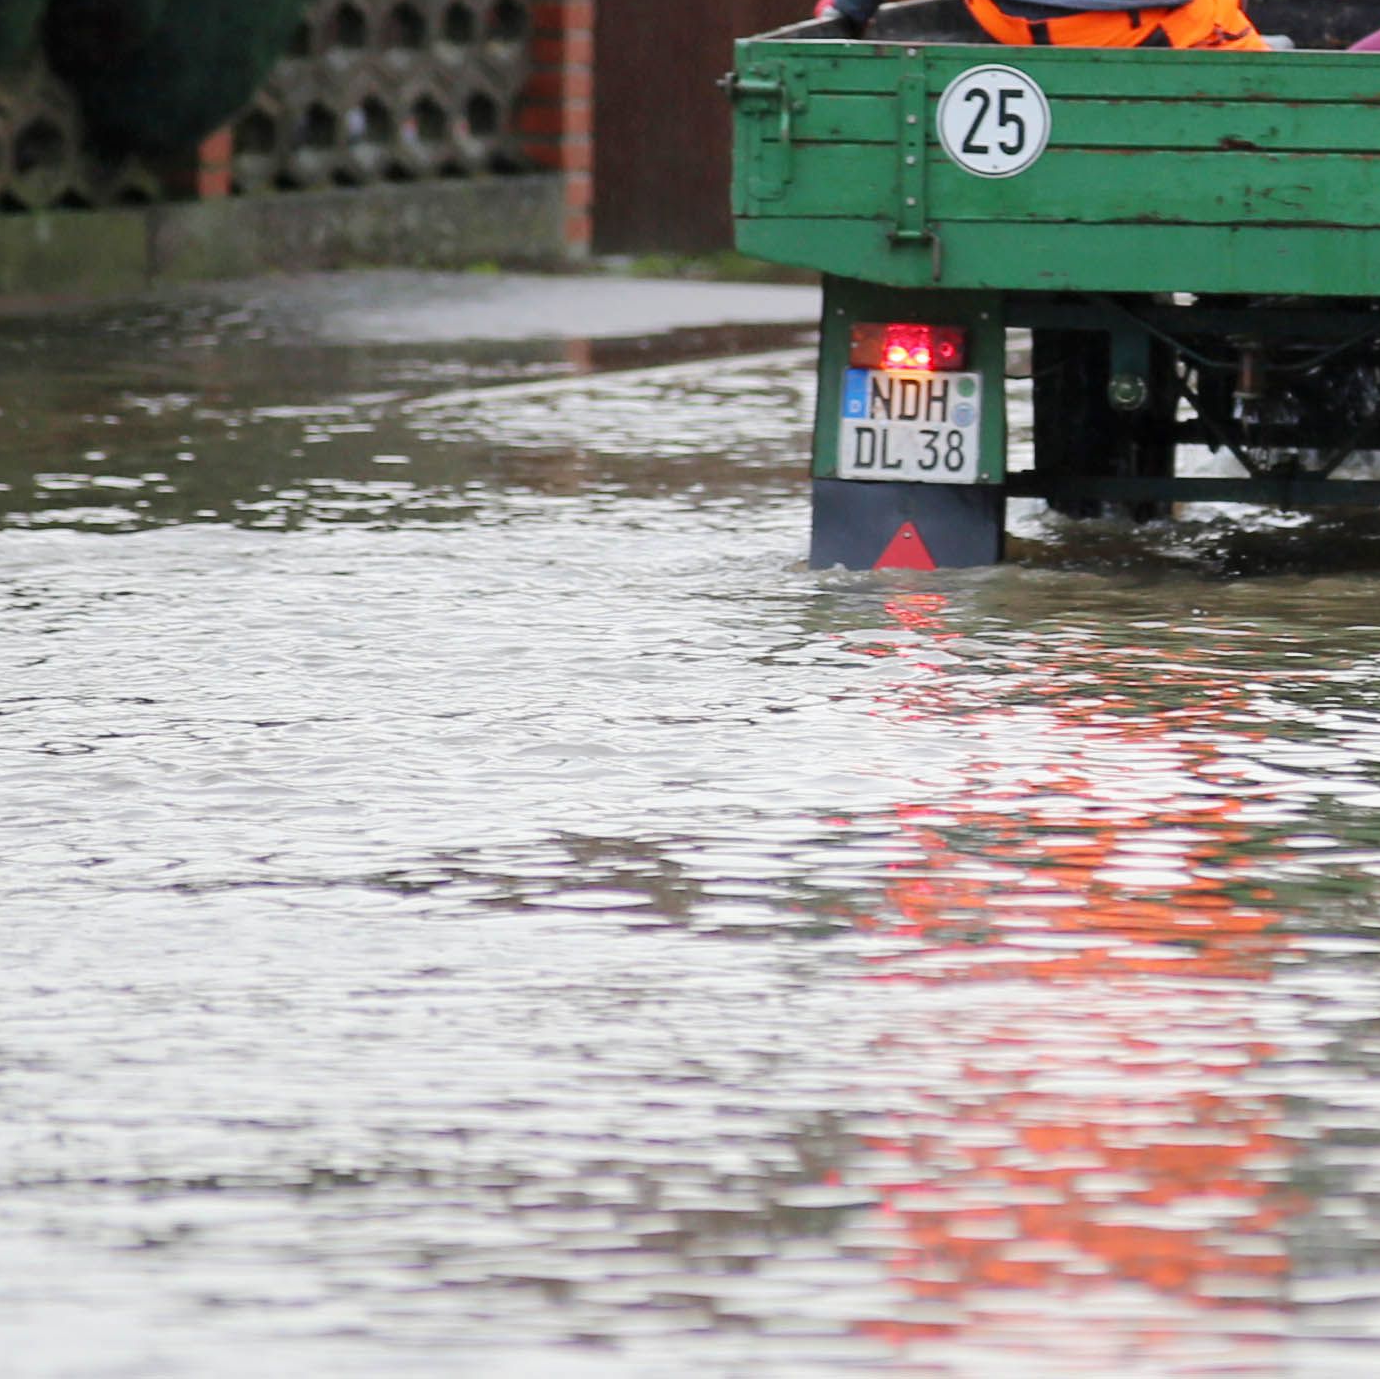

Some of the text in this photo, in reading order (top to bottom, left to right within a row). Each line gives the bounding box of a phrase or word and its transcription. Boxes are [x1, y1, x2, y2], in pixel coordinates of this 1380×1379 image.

[961, 87, 1025, 156] 25
[870, 377, 949, 422] NDH
[853, 427, 964, 472] DL 38
